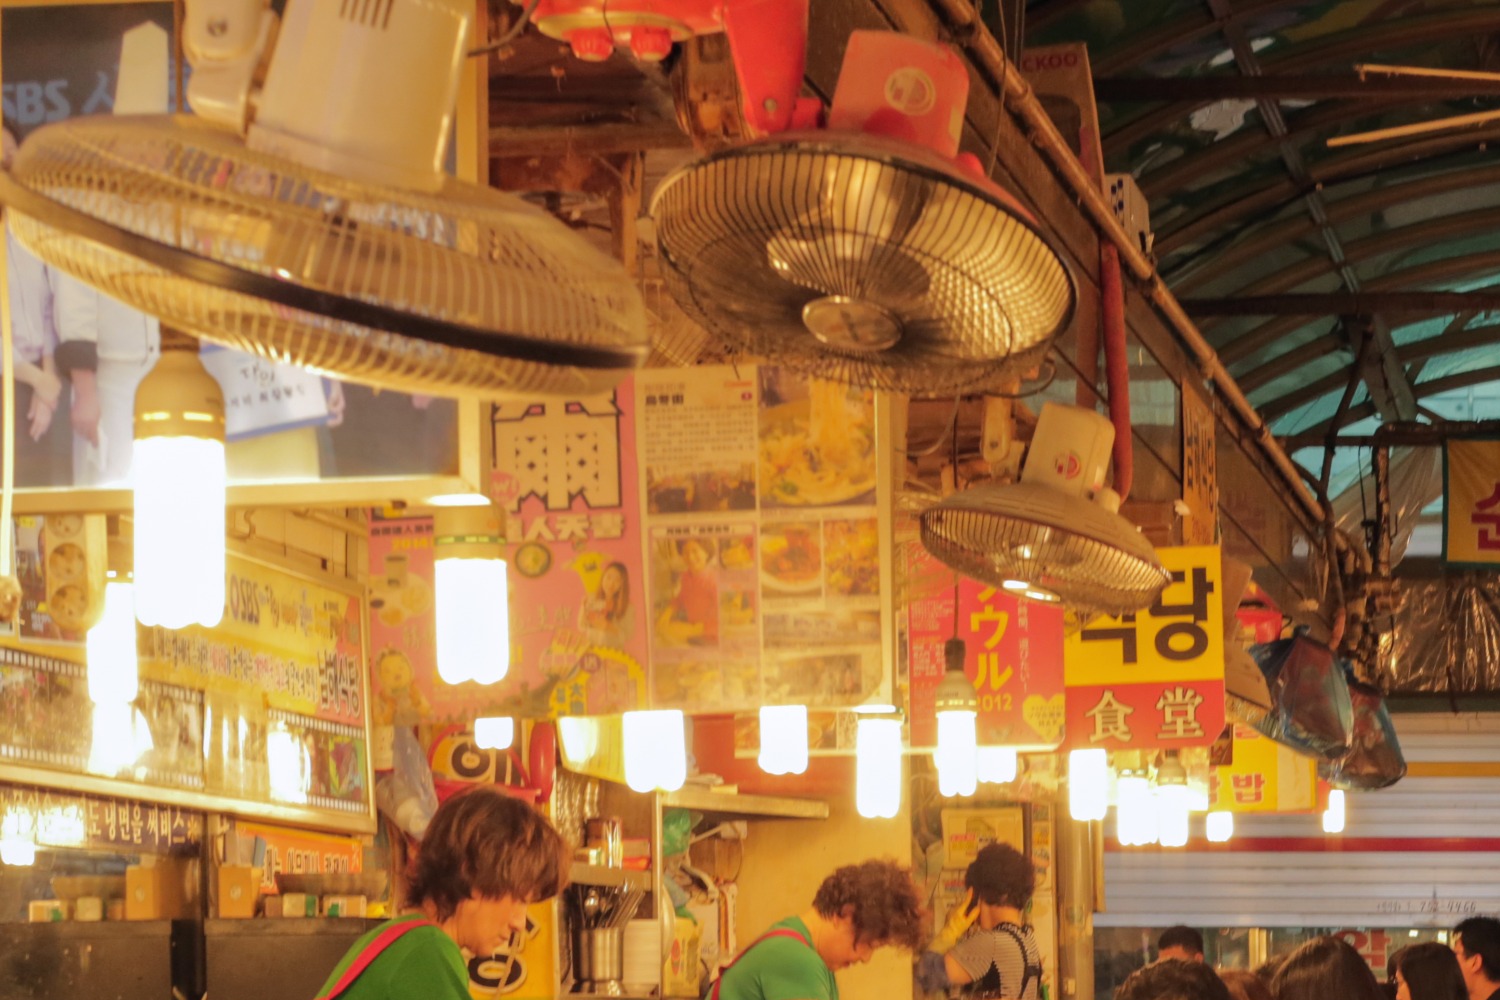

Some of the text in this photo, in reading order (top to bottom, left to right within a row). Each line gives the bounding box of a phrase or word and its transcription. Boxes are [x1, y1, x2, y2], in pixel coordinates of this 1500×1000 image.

[967, 585, 1014, 692] ウル
[977, 693, 1012, 712] 012
[1084, 686, 1205, 744] 食堂
